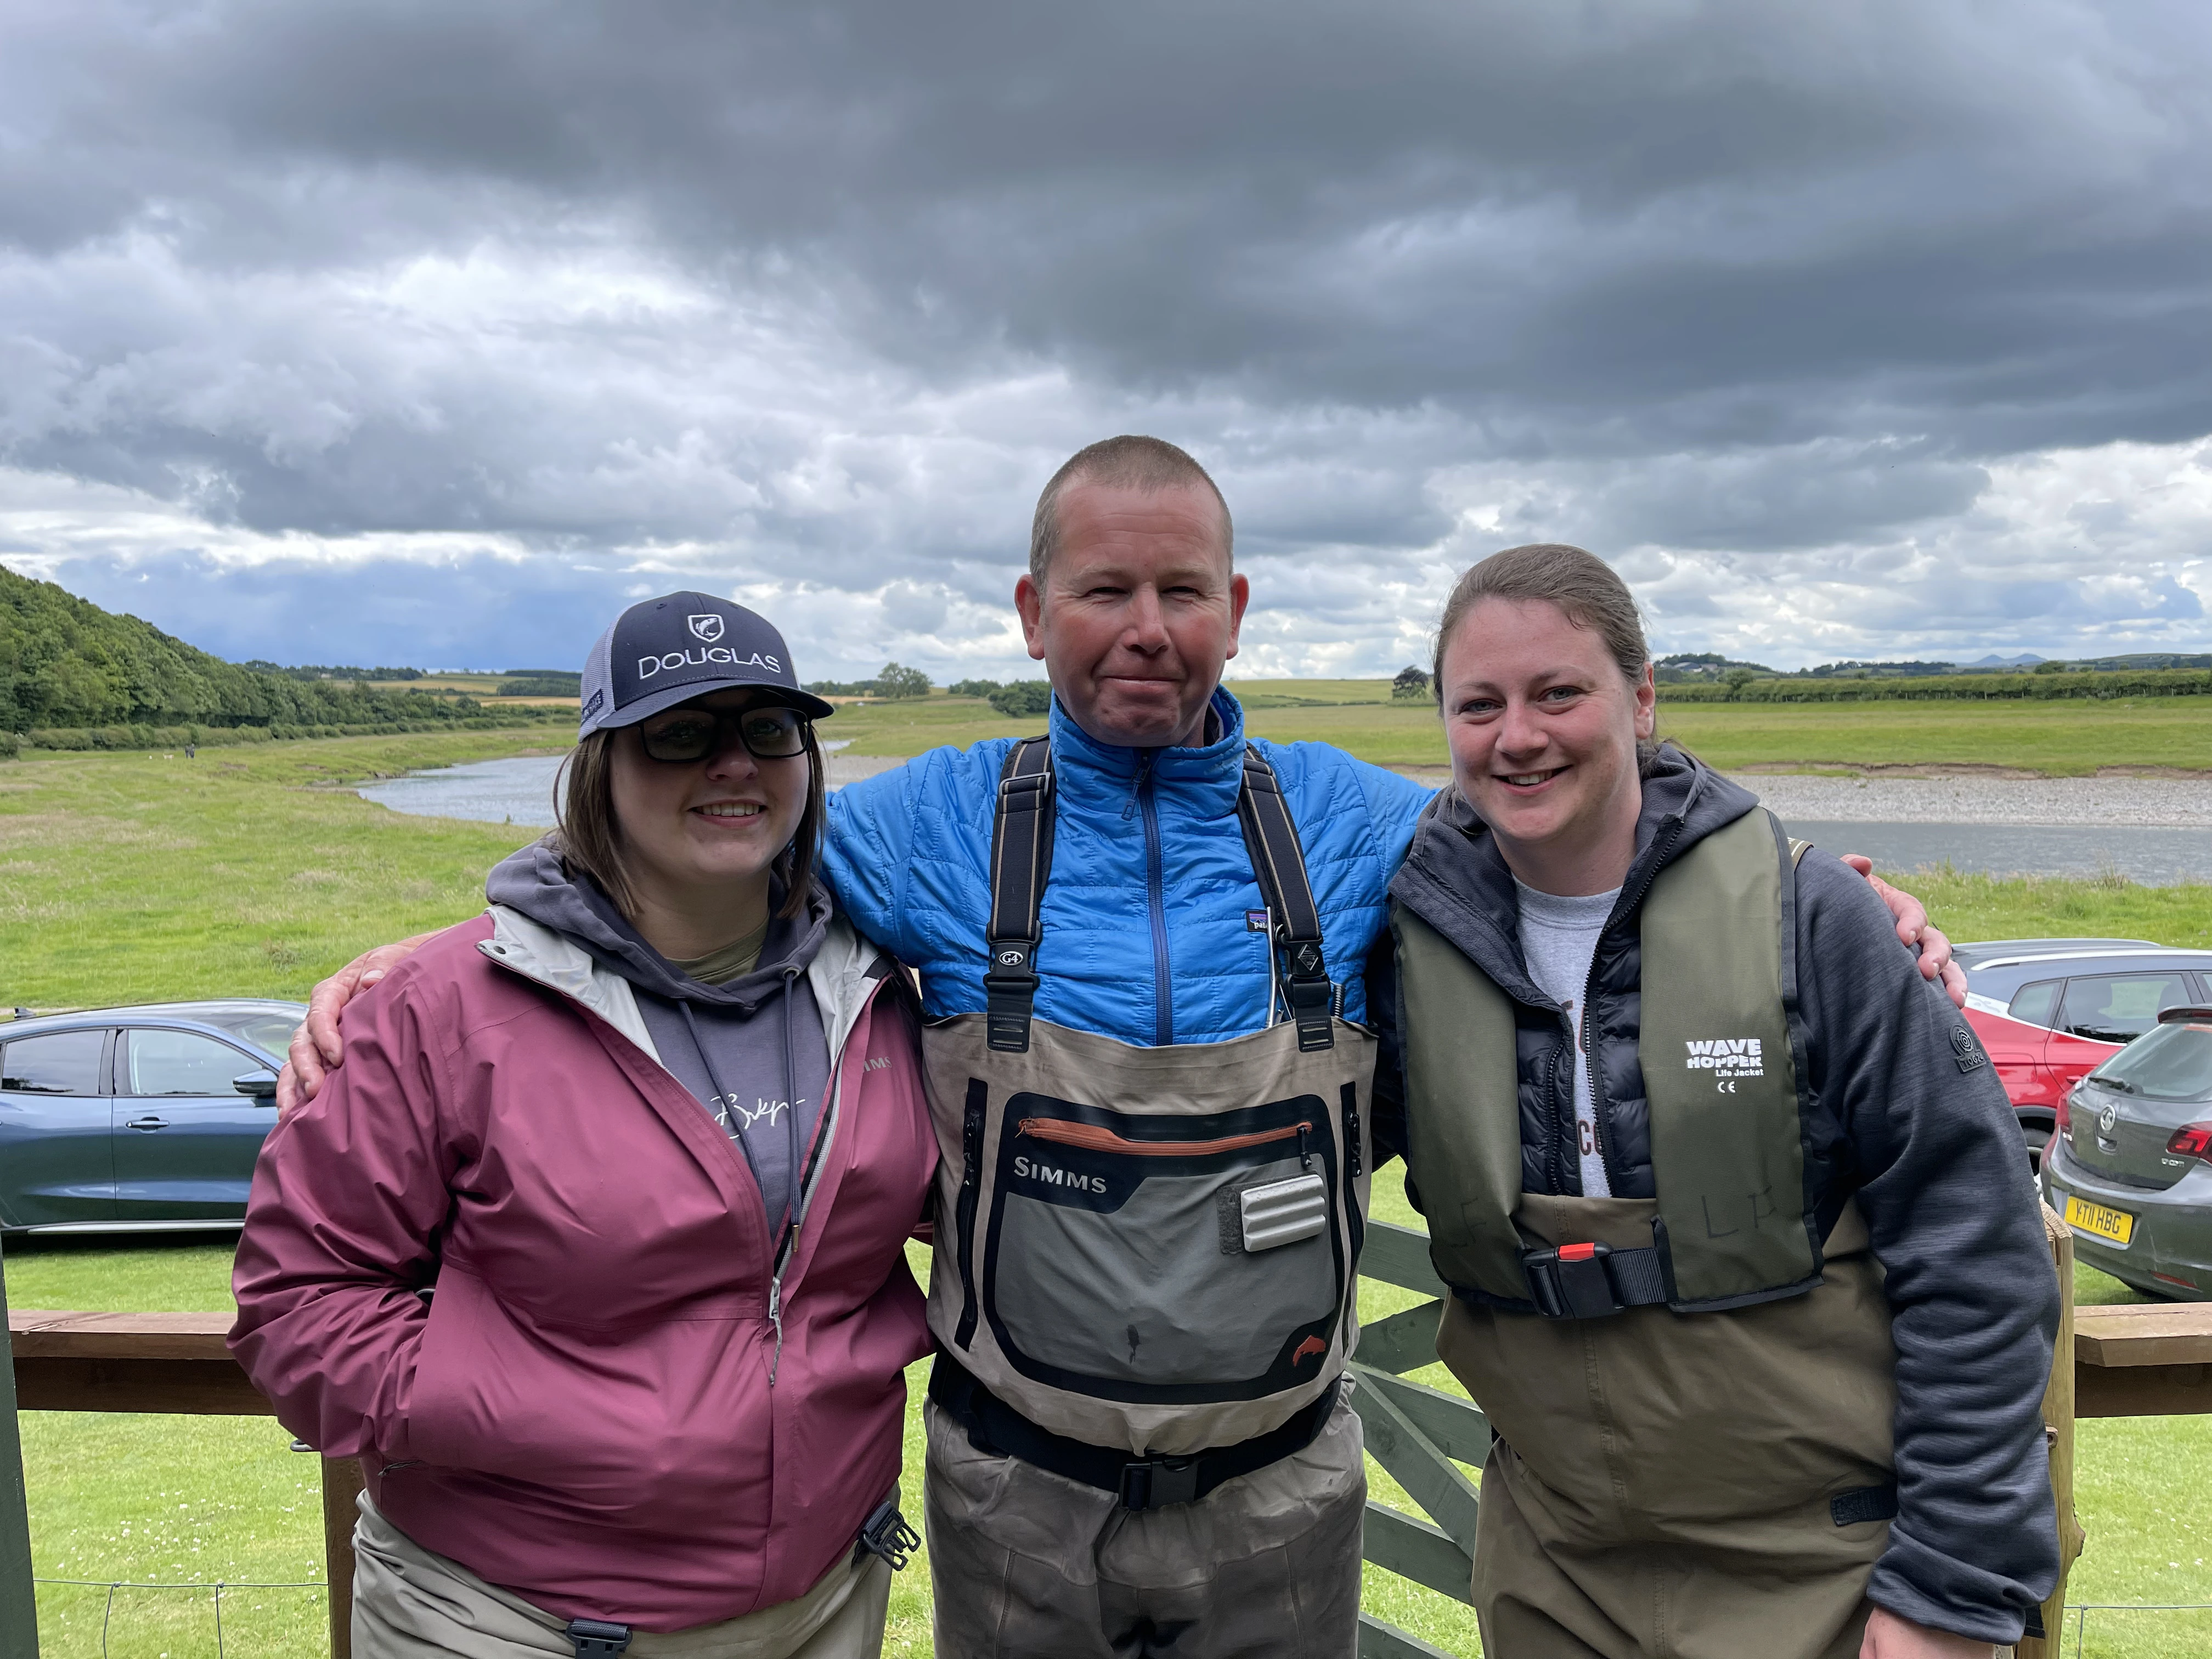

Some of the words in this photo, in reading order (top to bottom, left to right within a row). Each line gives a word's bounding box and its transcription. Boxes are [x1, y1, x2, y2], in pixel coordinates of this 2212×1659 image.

[638, 647, 781, 680] DOUGLAS
[1002, 953, 1018, 963] G4
[1686, 1039, 1762, 1056] WAVE
[1687, 1055, 1763, 1069] HOPPER
[1014, 1156, 1107, 1193] SIMMS
